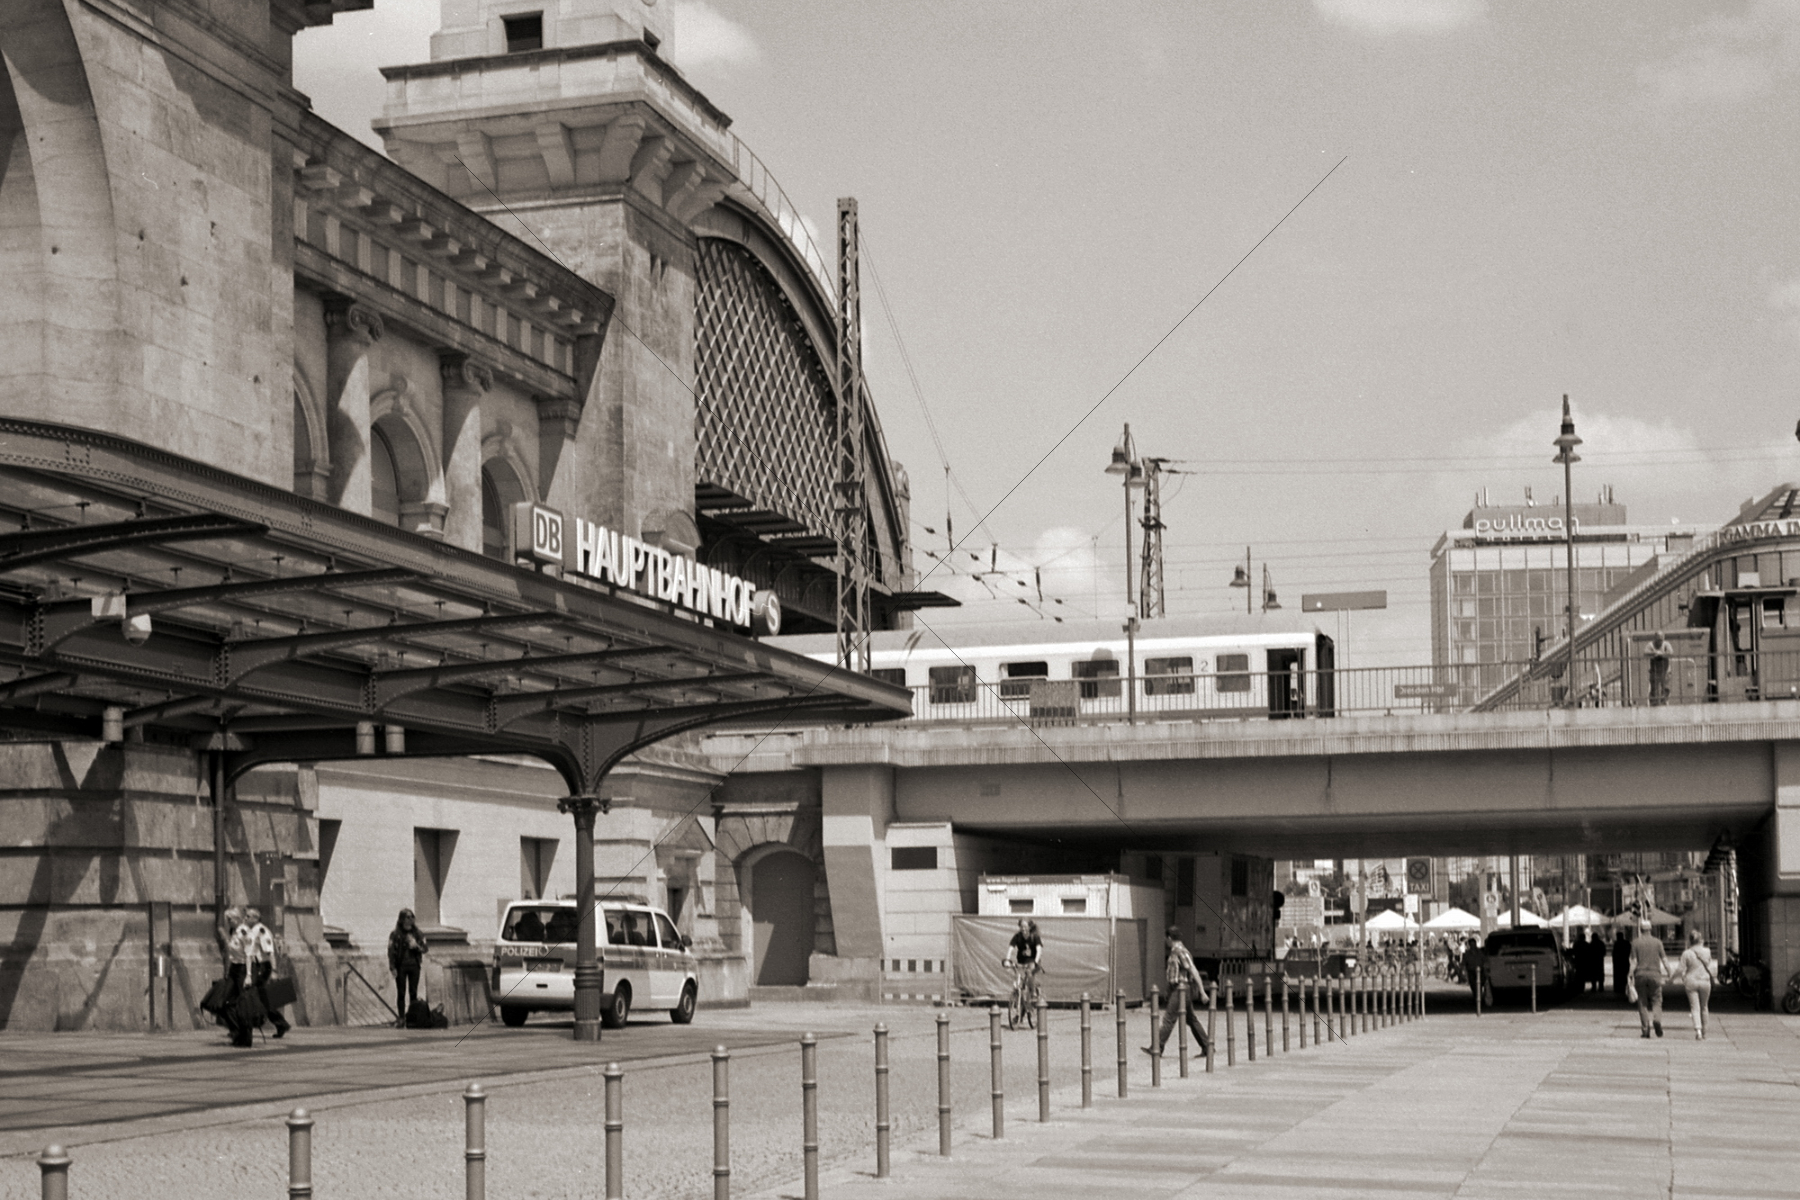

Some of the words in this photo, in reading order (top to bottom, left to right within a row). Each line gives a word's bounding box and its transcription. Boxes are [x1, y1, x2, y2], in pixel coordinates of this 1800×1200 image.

[536, 511, 560, 554] DB
[1476, 514, 1579, 537] pullman
[1724, 521, 1783, 542] GAMMA
[576, 517, 756, 627] HAUPTBAHNHOF
[768, 594, 778, 632] S
[1200, 660, 1208, 673] 2
[1410, 882, 1429, 893] TAXI
[501, 947, 538, 957] POLIZEI
